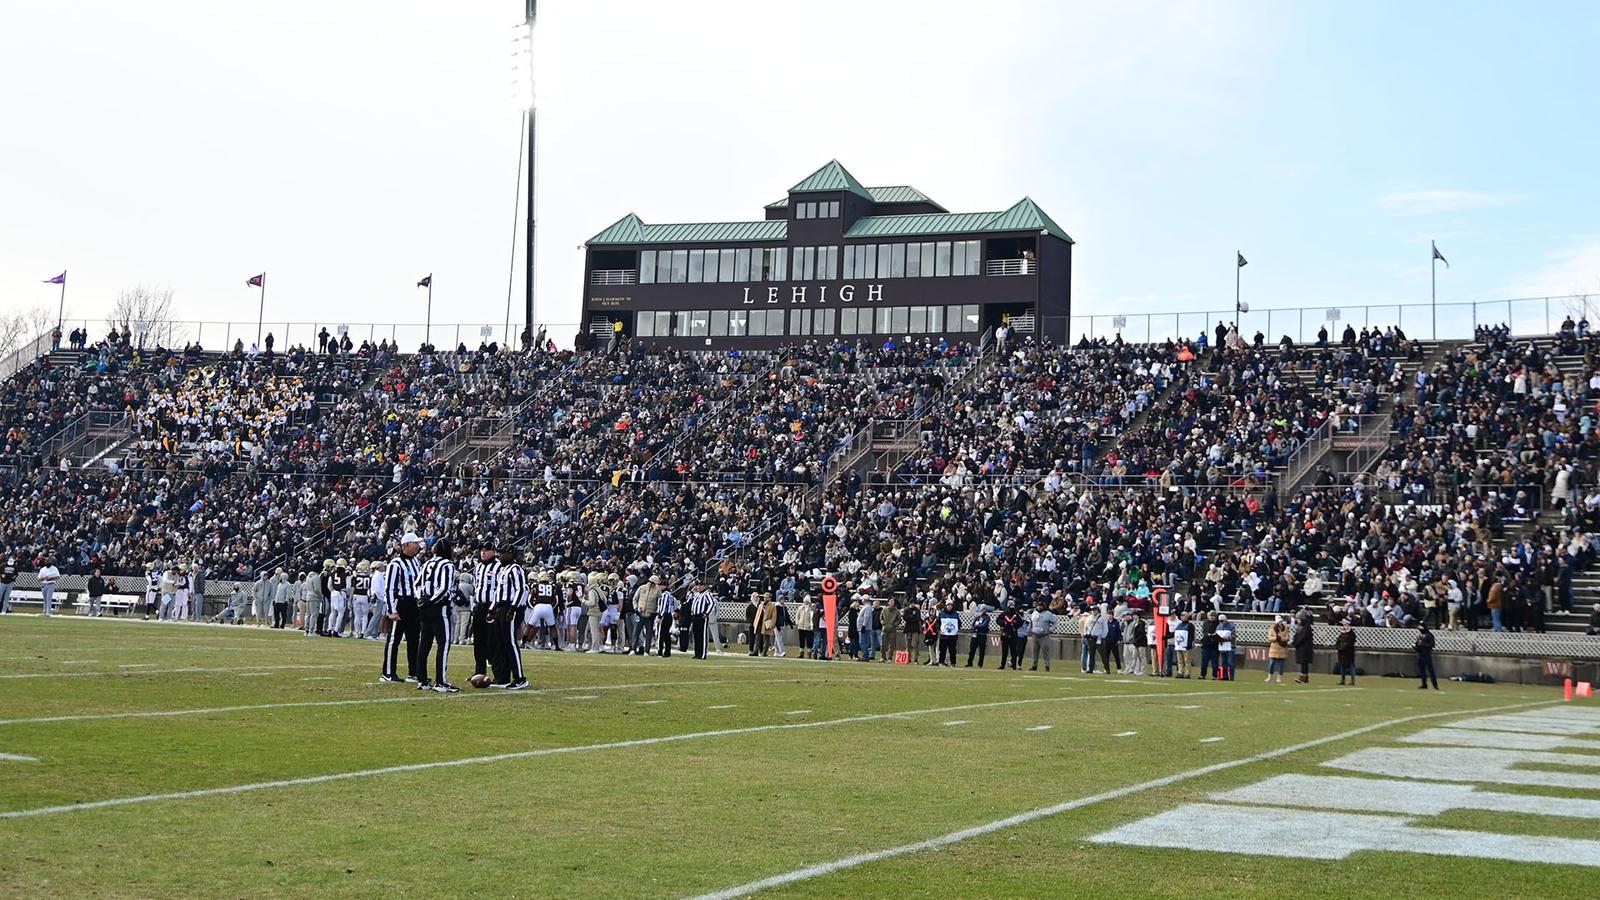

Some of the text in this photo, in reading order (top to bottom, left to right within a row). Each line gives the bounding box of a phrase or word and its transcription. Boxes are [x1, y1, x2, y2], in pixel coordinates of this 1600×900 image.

[743, 284, 884, 304] LEHIGH
[355, 576, 370, 590] 20
[538, 583, 553, 597] 98
[896, 652, 907, 663] 20
